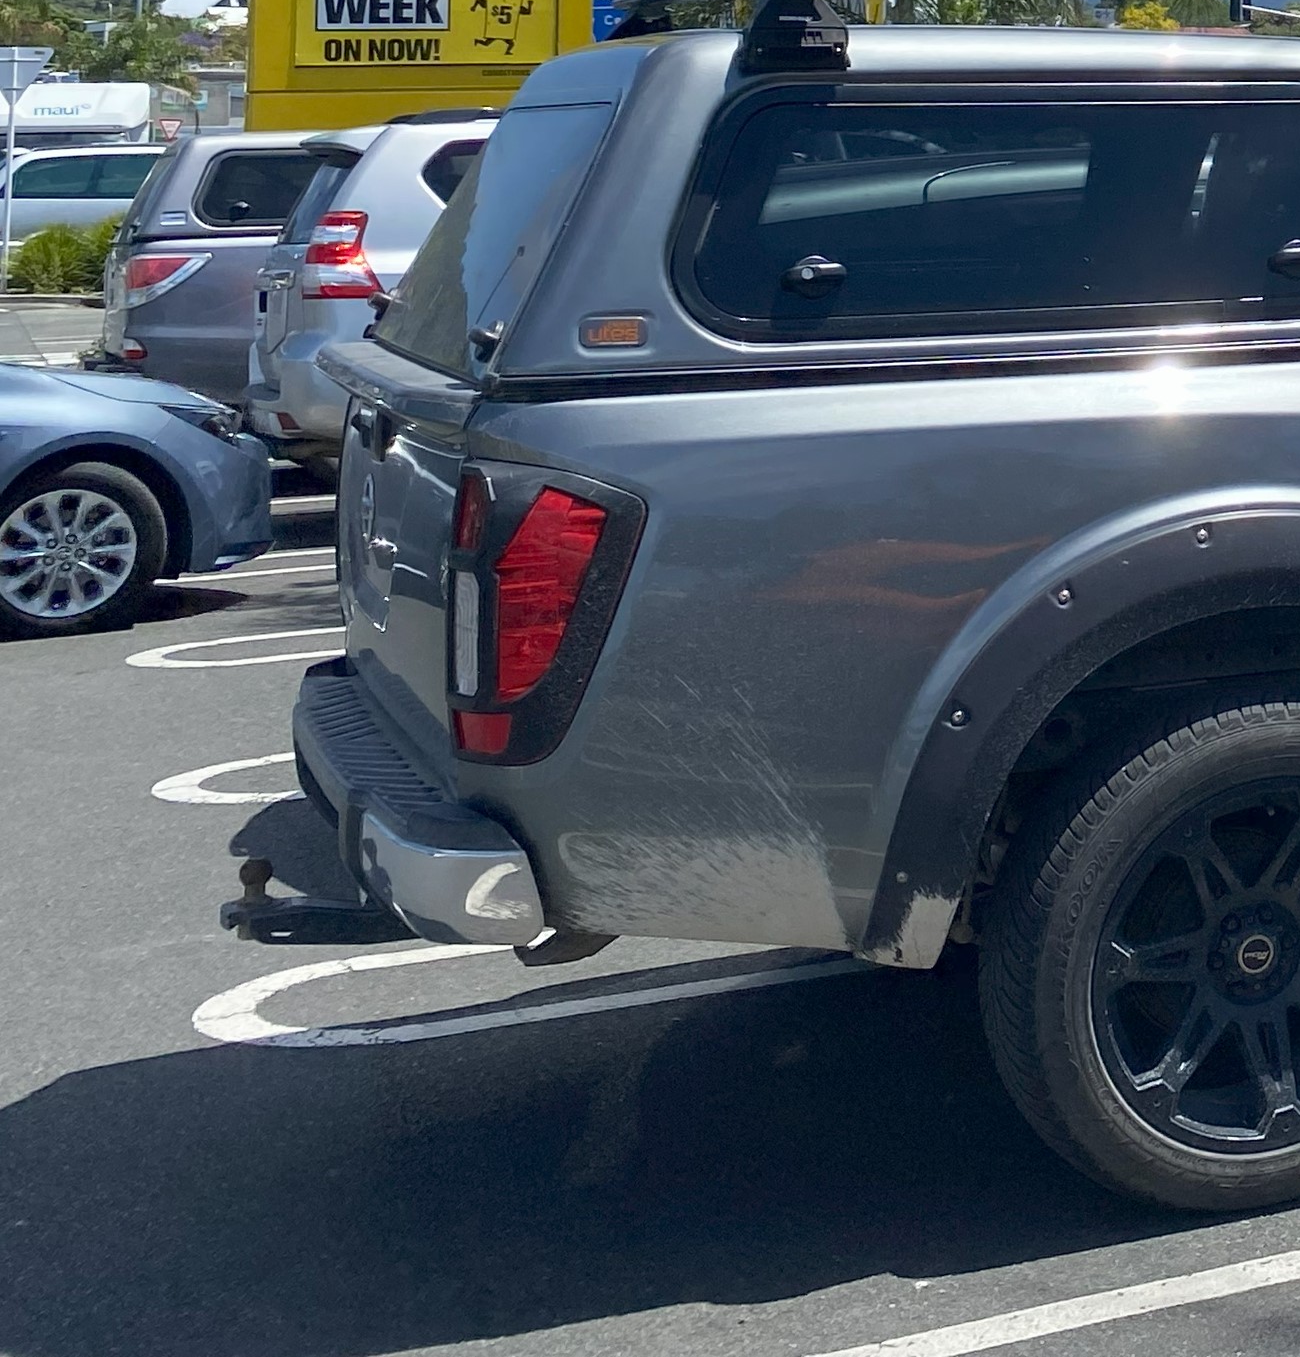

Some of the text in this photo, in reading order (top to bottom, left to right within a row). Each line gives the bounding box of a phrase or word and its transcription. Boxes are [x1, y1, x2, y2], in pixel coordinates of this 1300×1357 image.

[491, 5, 513, 24] $5
[324, 38, 440, 61] ON NOW!
[34, 105, 79, 116] maui
